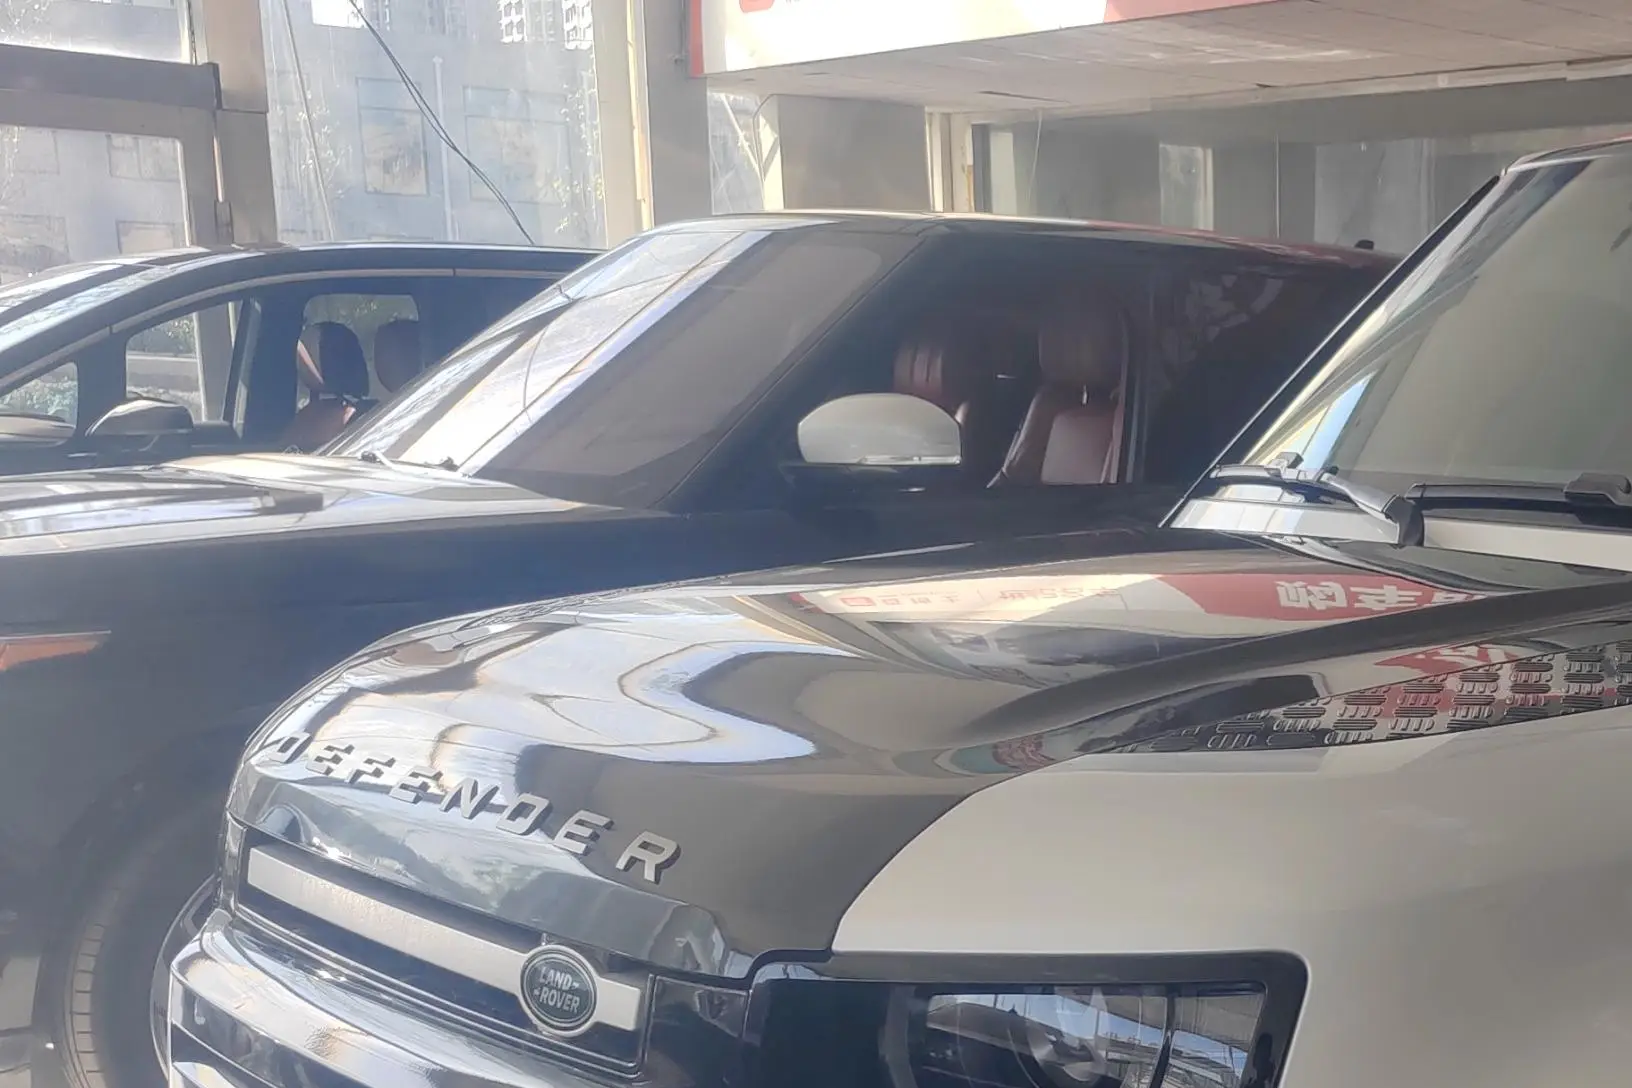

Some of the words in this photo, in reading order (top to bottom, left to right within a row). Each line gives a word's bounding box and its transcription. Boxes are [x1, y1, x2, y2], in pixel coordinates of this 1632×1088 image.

[268, 731, 681, 884] DEFENDER
[538, 966, 574, 991] LAND
[538, 985, 581, 1014] ROVER
